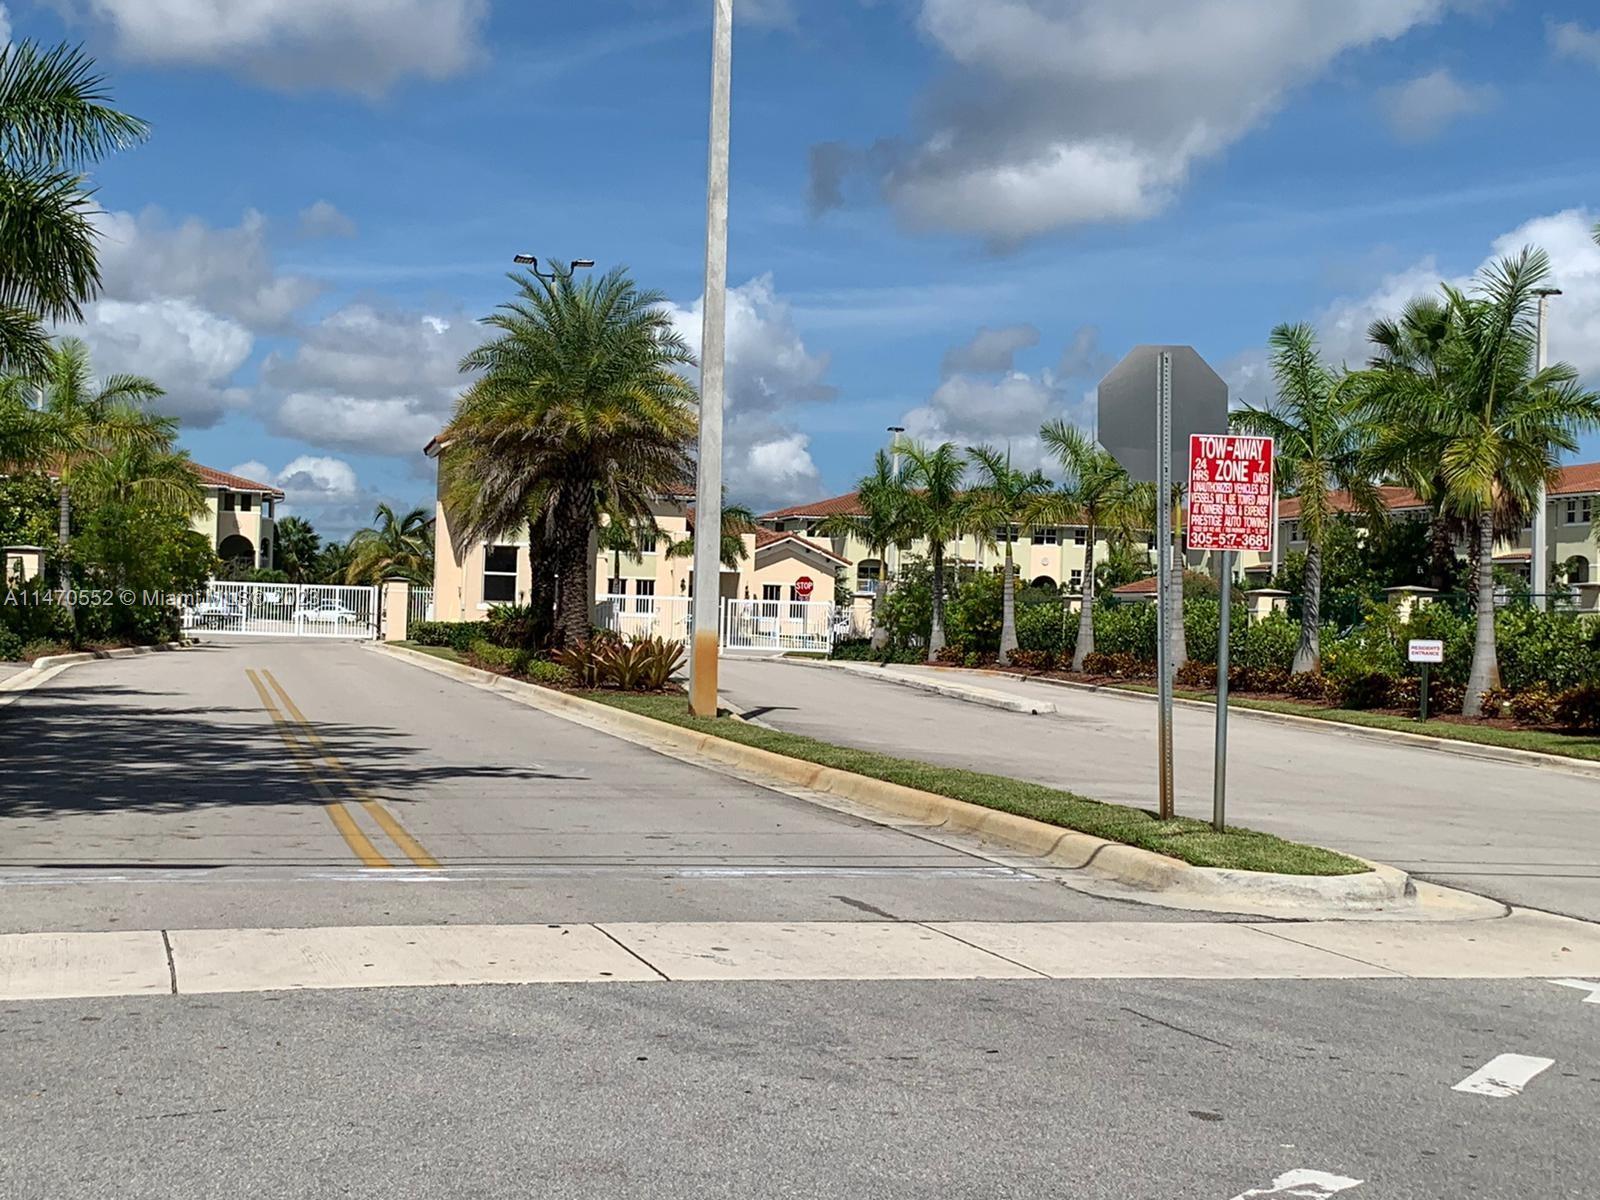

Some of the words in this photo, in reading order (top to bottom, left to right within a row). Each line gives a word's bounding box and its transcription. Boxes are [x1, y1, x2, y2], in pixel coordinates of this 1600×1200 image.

[1199, 437, 1264, 460] TOW-AWAY
[1195, 458, 1207, 470] 24
[1258, 461, 1265, 472] 7
[1192, 470, 1209, 481] HRS
[1215, 460, 1249, 482] ZONE
[1252, 472, 1269, 483] DAYS
[1193, 482, 1232, 494] UNAUTHORIZED
[1234, 483, 1258, 494] VEHICLES
[1260, 485, 1268, 495] OR
[1191, 493, 1214, 503] VESSELS
[1216, 494, 1227, 504] WILL
[1229, 494, 1236, 504] BE
[1238, 494, 1255, 505] TOWED
[1256, 495, 1269, 505] AWAY
[1225, 505, 1237, 515] RISK
[1244, 506, 1268, 516] EXPENSE
[1191, 515, 1222, 526] PRESTIGE
[1224, 516, 1241, 527] AUTO
[1243, 517, 1268, 528] TOWING
[796, 582, 812, 590] STOP
